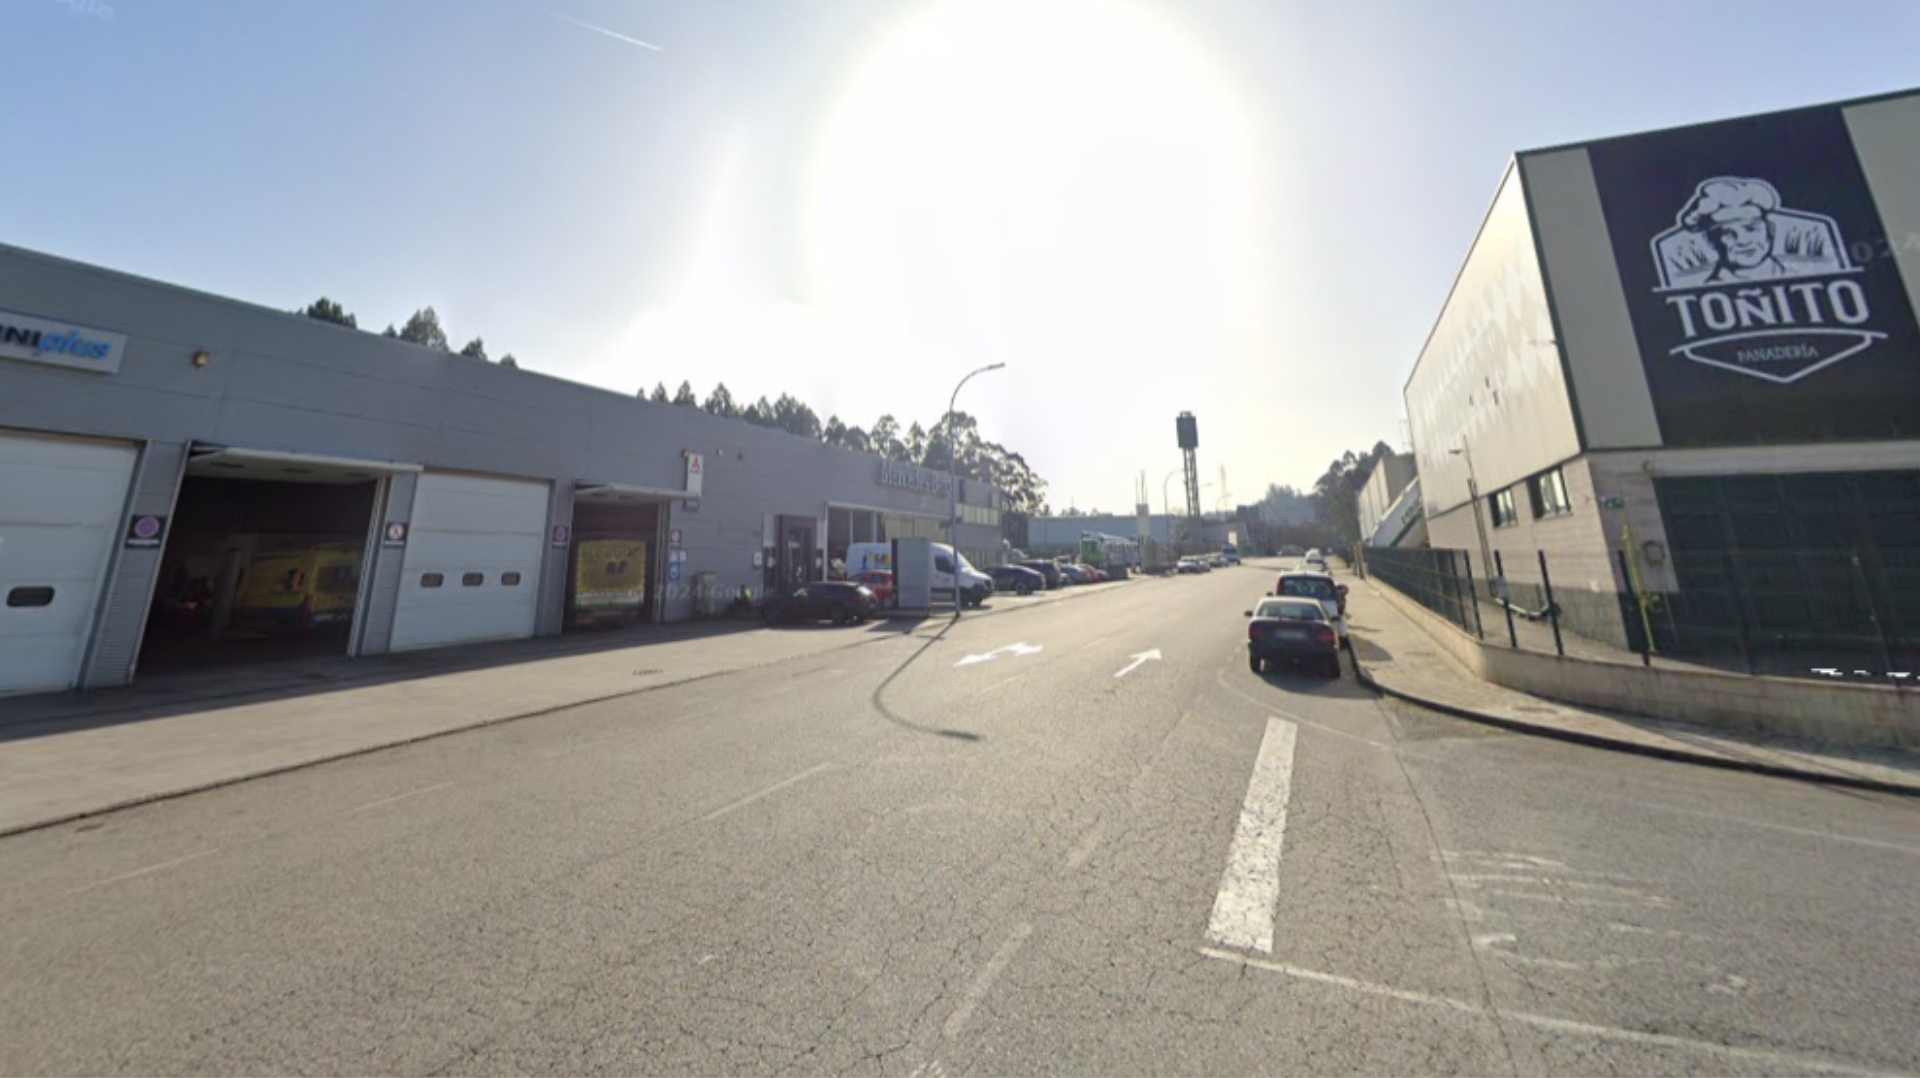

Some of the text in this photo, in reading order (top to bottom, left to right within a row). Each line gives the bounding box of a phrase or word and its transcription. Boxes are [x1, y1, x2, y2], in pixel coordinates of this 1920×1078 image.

[1665, 279, 1870, 338] TOÑITO
[0, 324, 112, 360] NIplus
[1737, 344, 1819, 363] PANADERÍA
